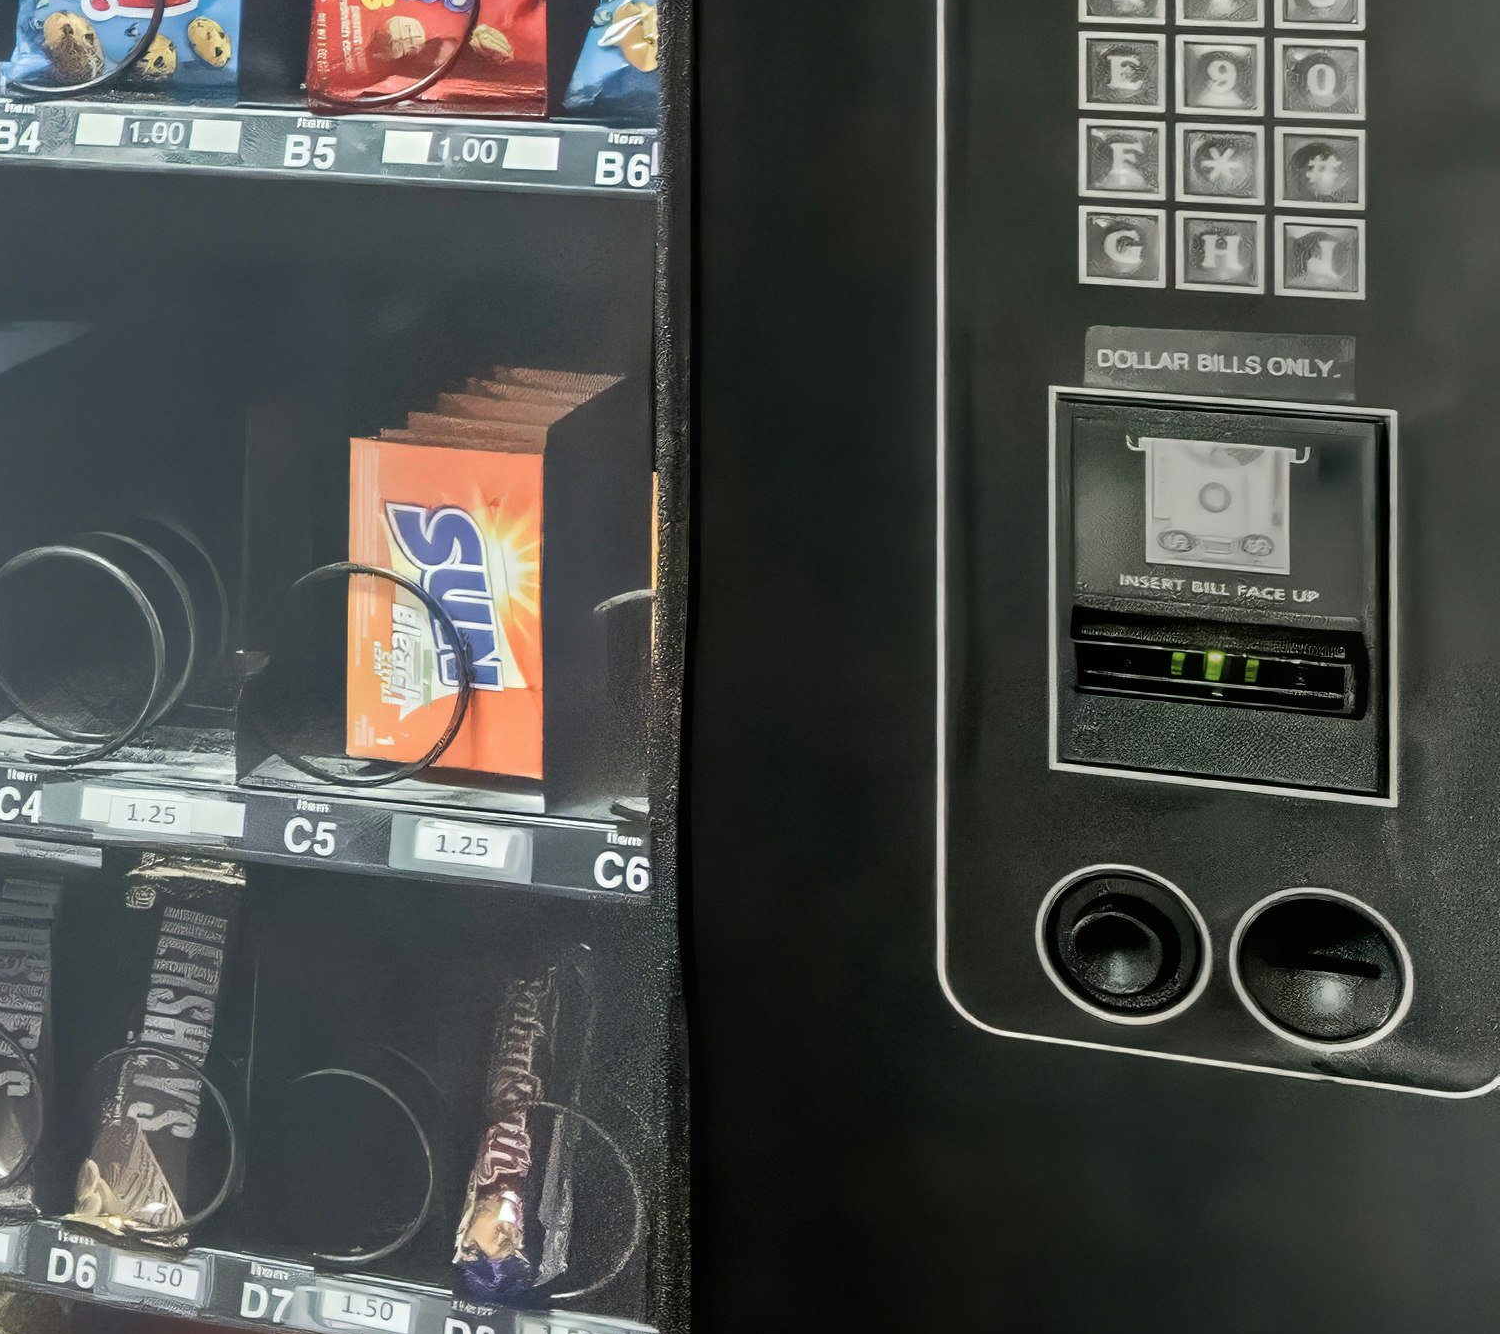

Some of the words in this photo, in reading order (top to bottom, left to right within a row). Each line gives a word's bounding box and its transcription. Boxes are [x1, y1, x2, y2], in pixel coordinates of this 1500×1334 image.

[283, 134, 337, 169] B5
[439, 138, 499, 164] 1.00
[595, 152, 652, 188] B6
[1096, 348, 1190, 372] DOLLAR
[1197, 353, 1263, 375] BILLS
[1118, 573, 1184, 592] INSERT
[1191, 578, 1231, 597] BILL
[1237, 584, 1286, 601] FACE
[1292, 588, 1320, 604] UP
[126, 803, 177, 826] 1.25
[283, 817, 338, 857] C5
[434, 833, 490, 859] 1.25
[595, 852, 650, 893] C6
[47, 1247, 99, 1290] D6
[132, 1260, 184, 1289] 1.50
[241, 1282, 292, 1325] D7
[340, 1295, 395, 1322] 1.50
